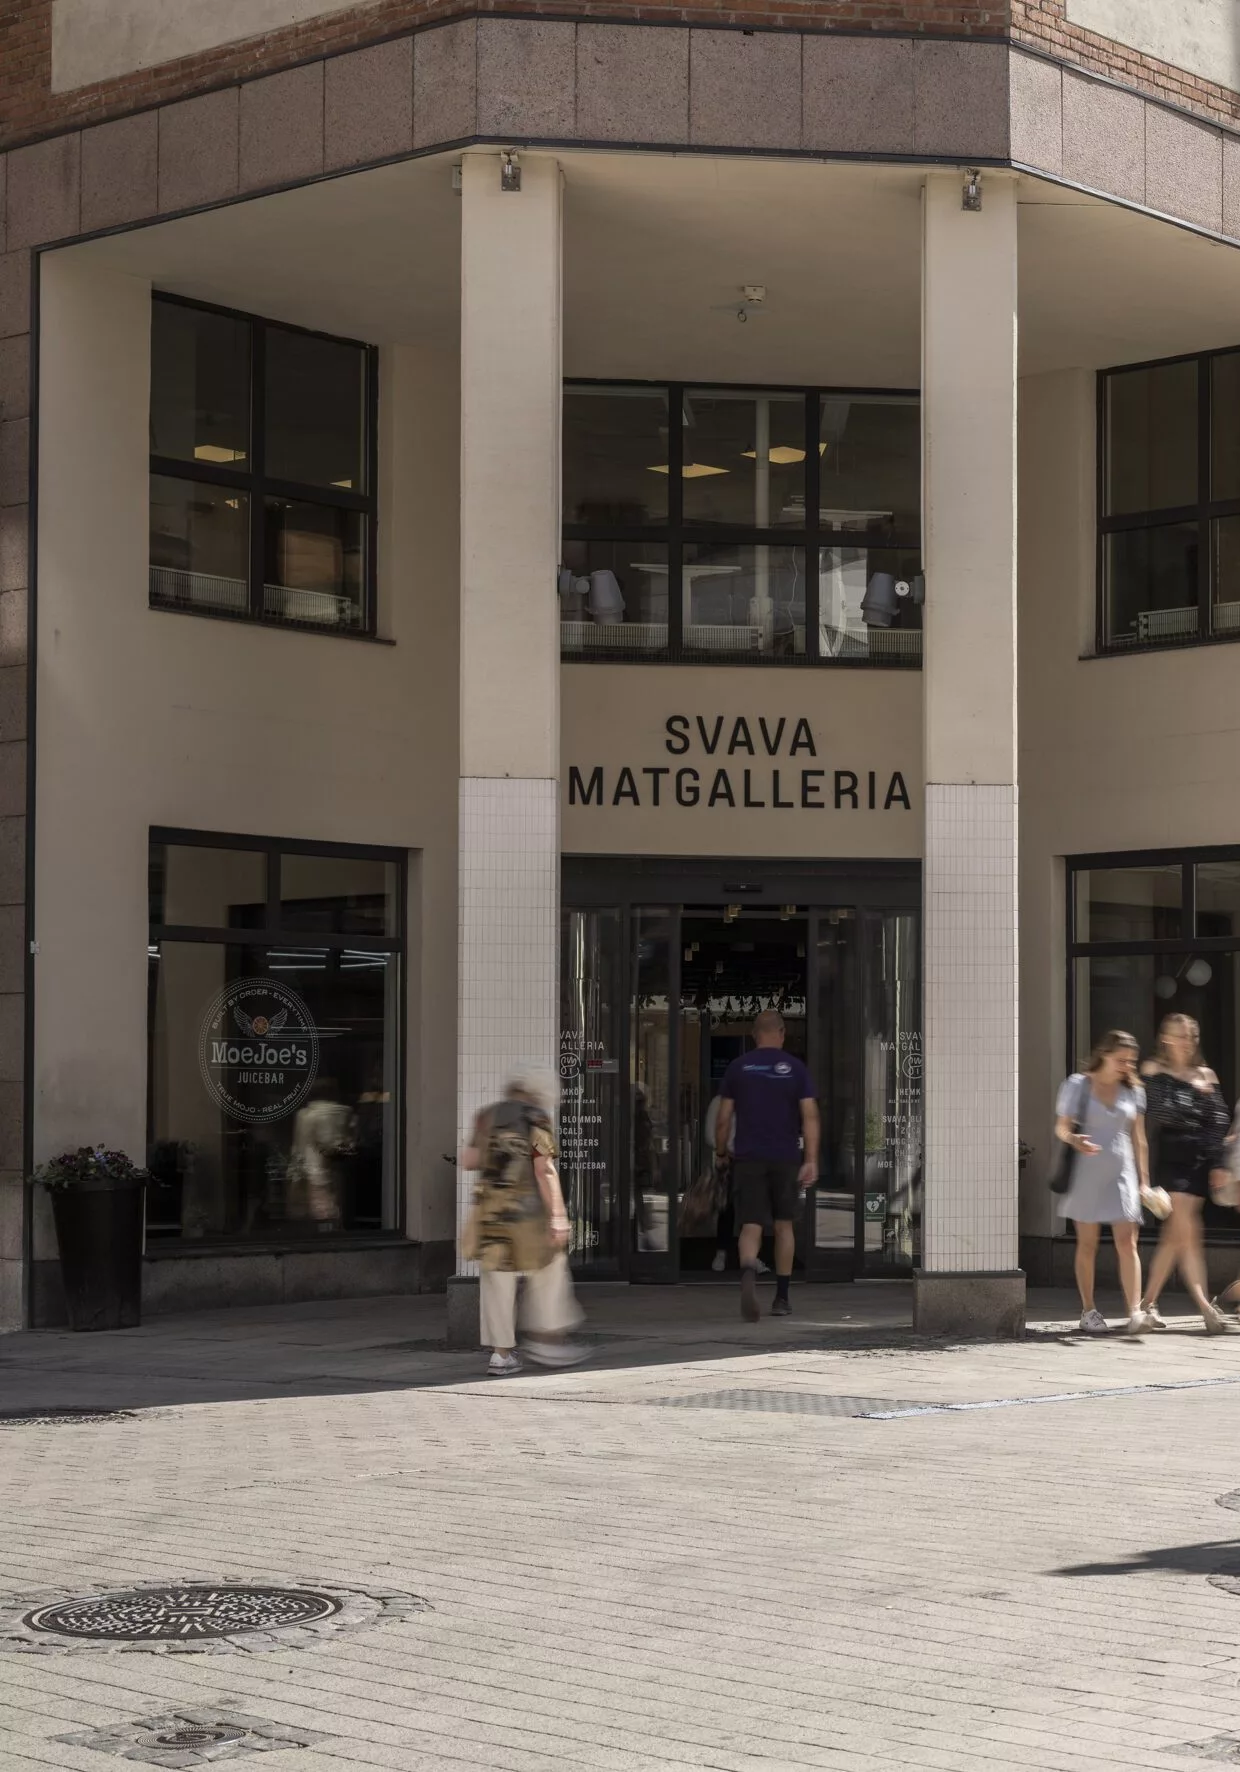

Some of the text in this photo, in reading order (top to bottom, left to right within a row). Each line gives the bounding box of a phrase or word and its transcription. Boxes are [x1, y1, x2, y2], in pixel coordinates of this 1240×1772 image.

[665, 714, 817, 756] SVAVA
[568, 766, 911, 810] MATGALLERIA
[212, 988, 308, 1033] BUILT BY ORDER EVERYTIME
[560, 1030, 584, 1039] VAVA
[900, 1031, 923, 1040] SVAV
[561, 1041, 604, 1050] ALLERIA
[211, 1041, 307, 1066] MoeJoe's
[237, 1072, 284, 1084] JUICEBAR
[561, 1086, 584, 1096] MKÖP
[899, 1088, 921, 1096] HEMK
[217, 1081, 302, 1113] TRUE MOJO REAL FRUIT
[562, 1115, 602, 1123] BLOMMOR
[562, 1138, 599, 1147] BURGERS
[560, 1150, 588, 1158] COLAT
[569, 1162, 606, 1170] JUICEBAR
